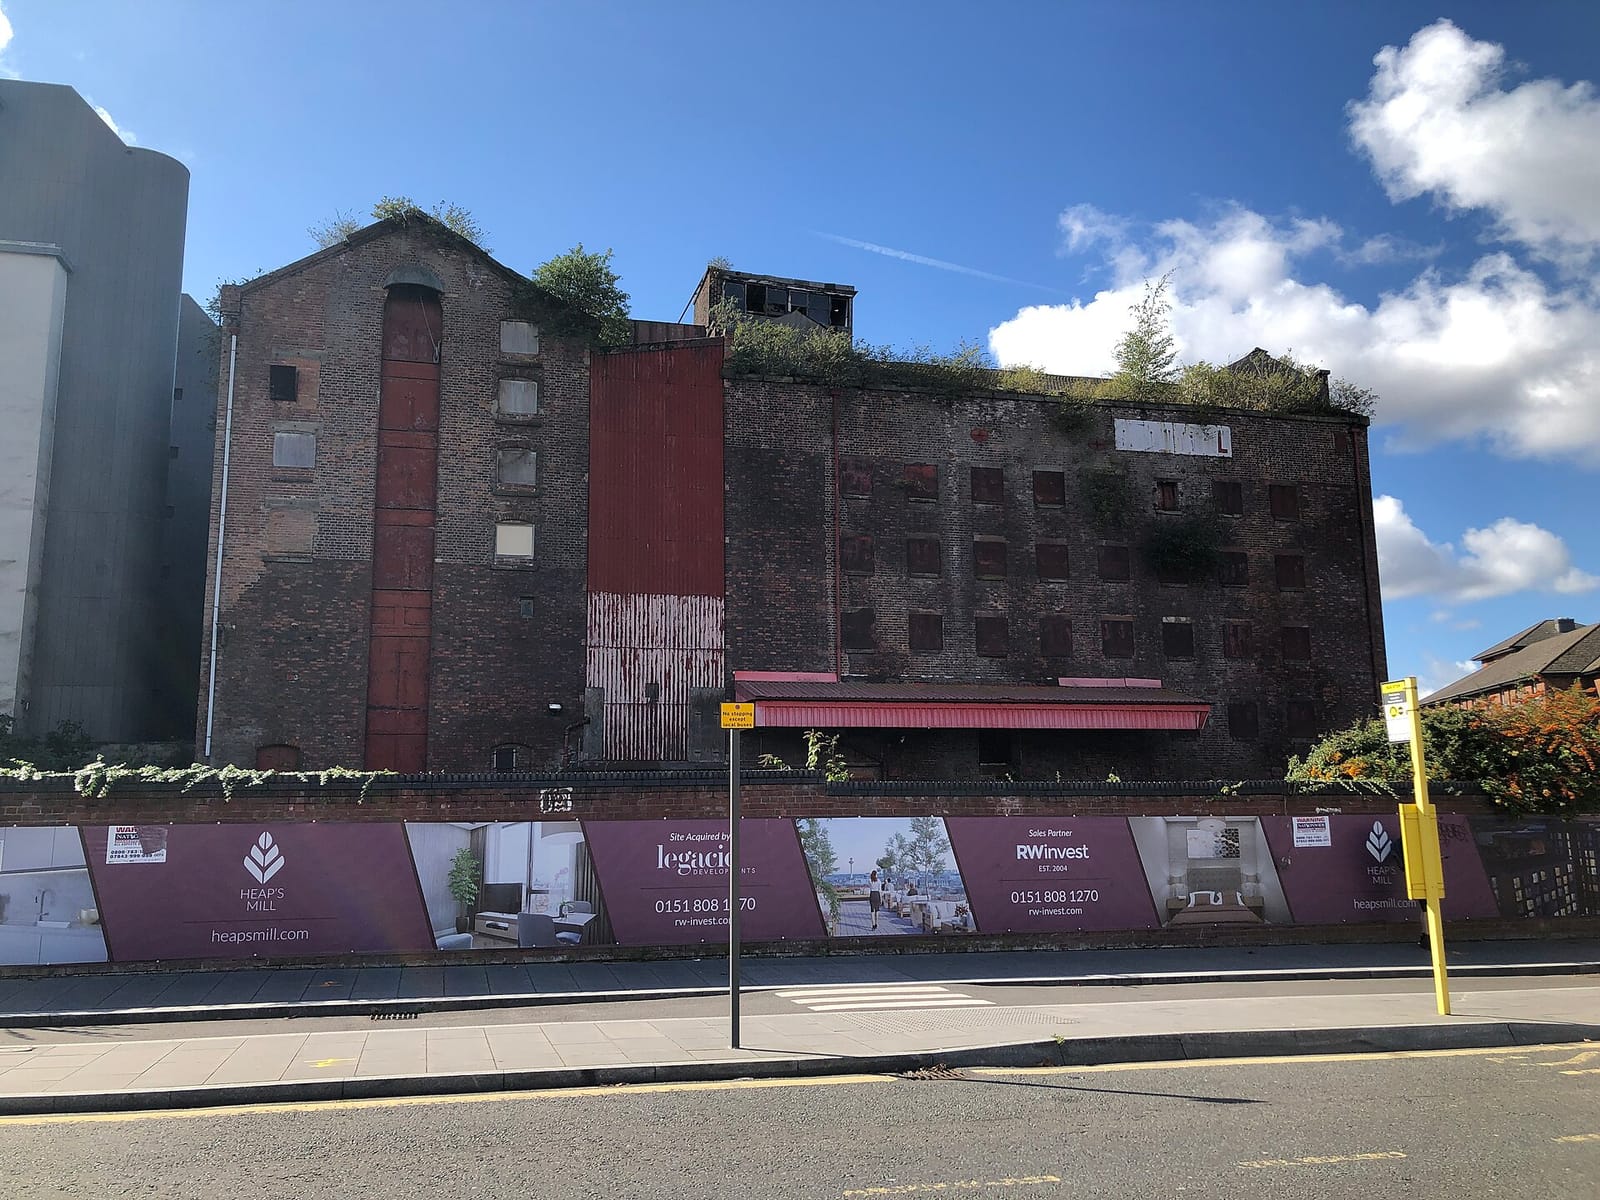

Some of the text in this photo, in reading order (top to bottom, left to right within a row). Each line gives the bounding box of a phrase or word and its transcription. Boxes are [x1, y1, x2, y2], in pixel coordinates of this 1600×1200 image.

[669, 832, 731, 842] Site Acquired by
[1028, 829, 1073, 838] Sales Partner
[1016, 844, 1090, 860] RWinvest
[693, 867, 756, 875] DEVELOPNTS
[1038, 864, 1068, 873] EST. 2004
[1367, 865, 1397, 876] HEAP'S
[1372, 876, 1393, 885] MILL
[240, 887, 285, 900] HEAP'S
[1011, 889, 1099, 904] 0151 808 1270
[246, 900, 277, 911] MILL
[655, 897, 756, 913] 0151 808 170
[1353, 898, 1417, 911] heapsmill.com
[1028, 906, 1083, 916] rw-invest.com
[673, 916, 731, 926] rw-invest.co
[211, 927, 309, 944] heapsmill.com
